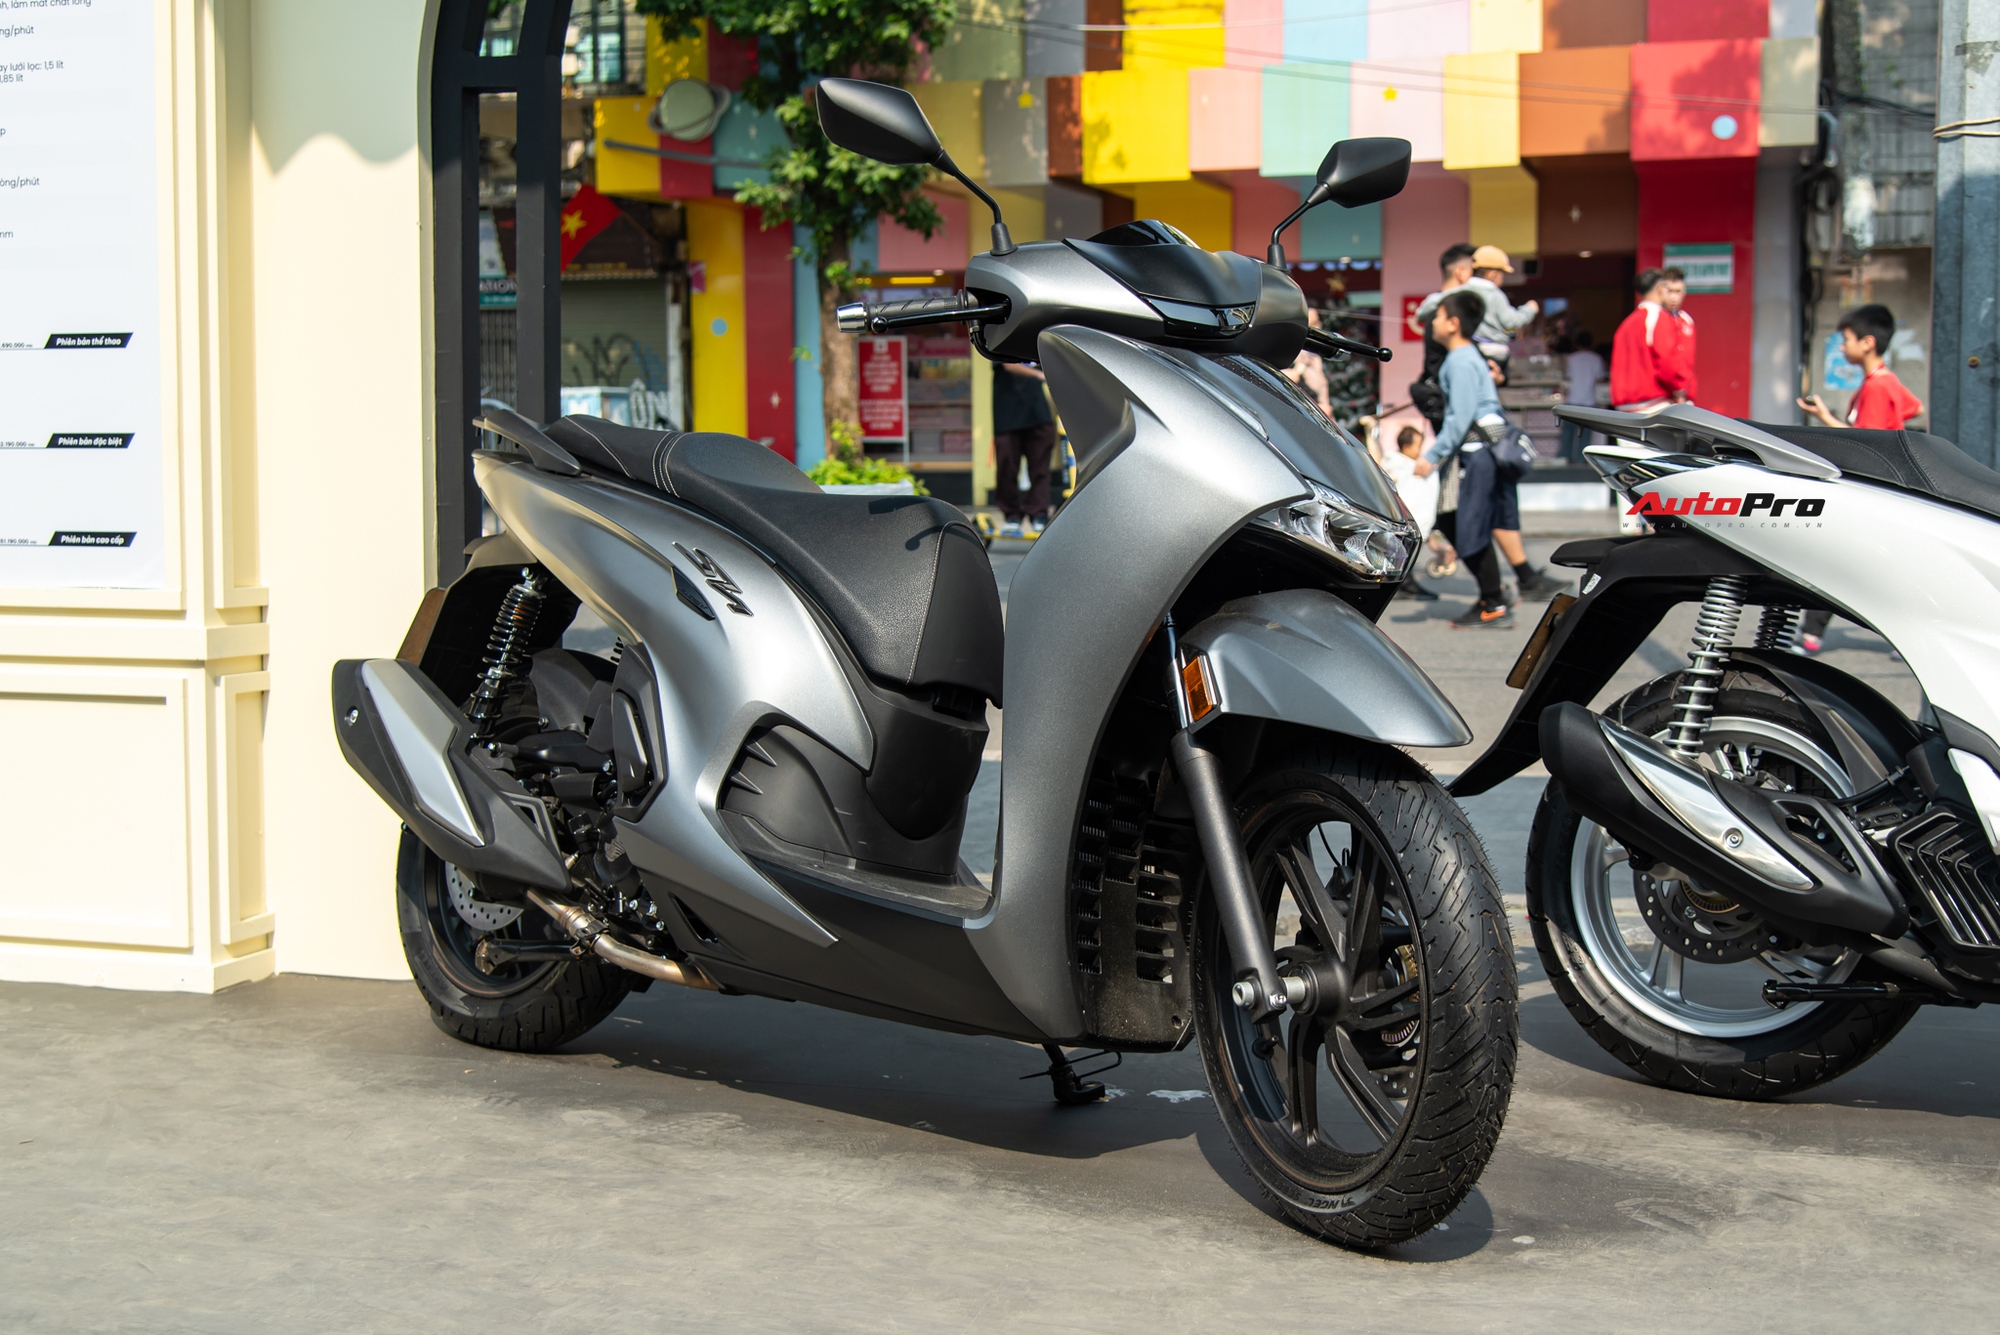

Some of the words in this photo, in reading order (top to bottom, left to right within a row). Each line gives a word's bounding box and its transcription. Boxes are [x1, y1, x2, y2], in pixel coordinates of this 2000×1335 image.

[56, 337, 76, 346] Phiên
[105, 337, 121, 345] thao
[58, 437, 78, 446] Phiên
[61, 535, 81, 544] Phiên
